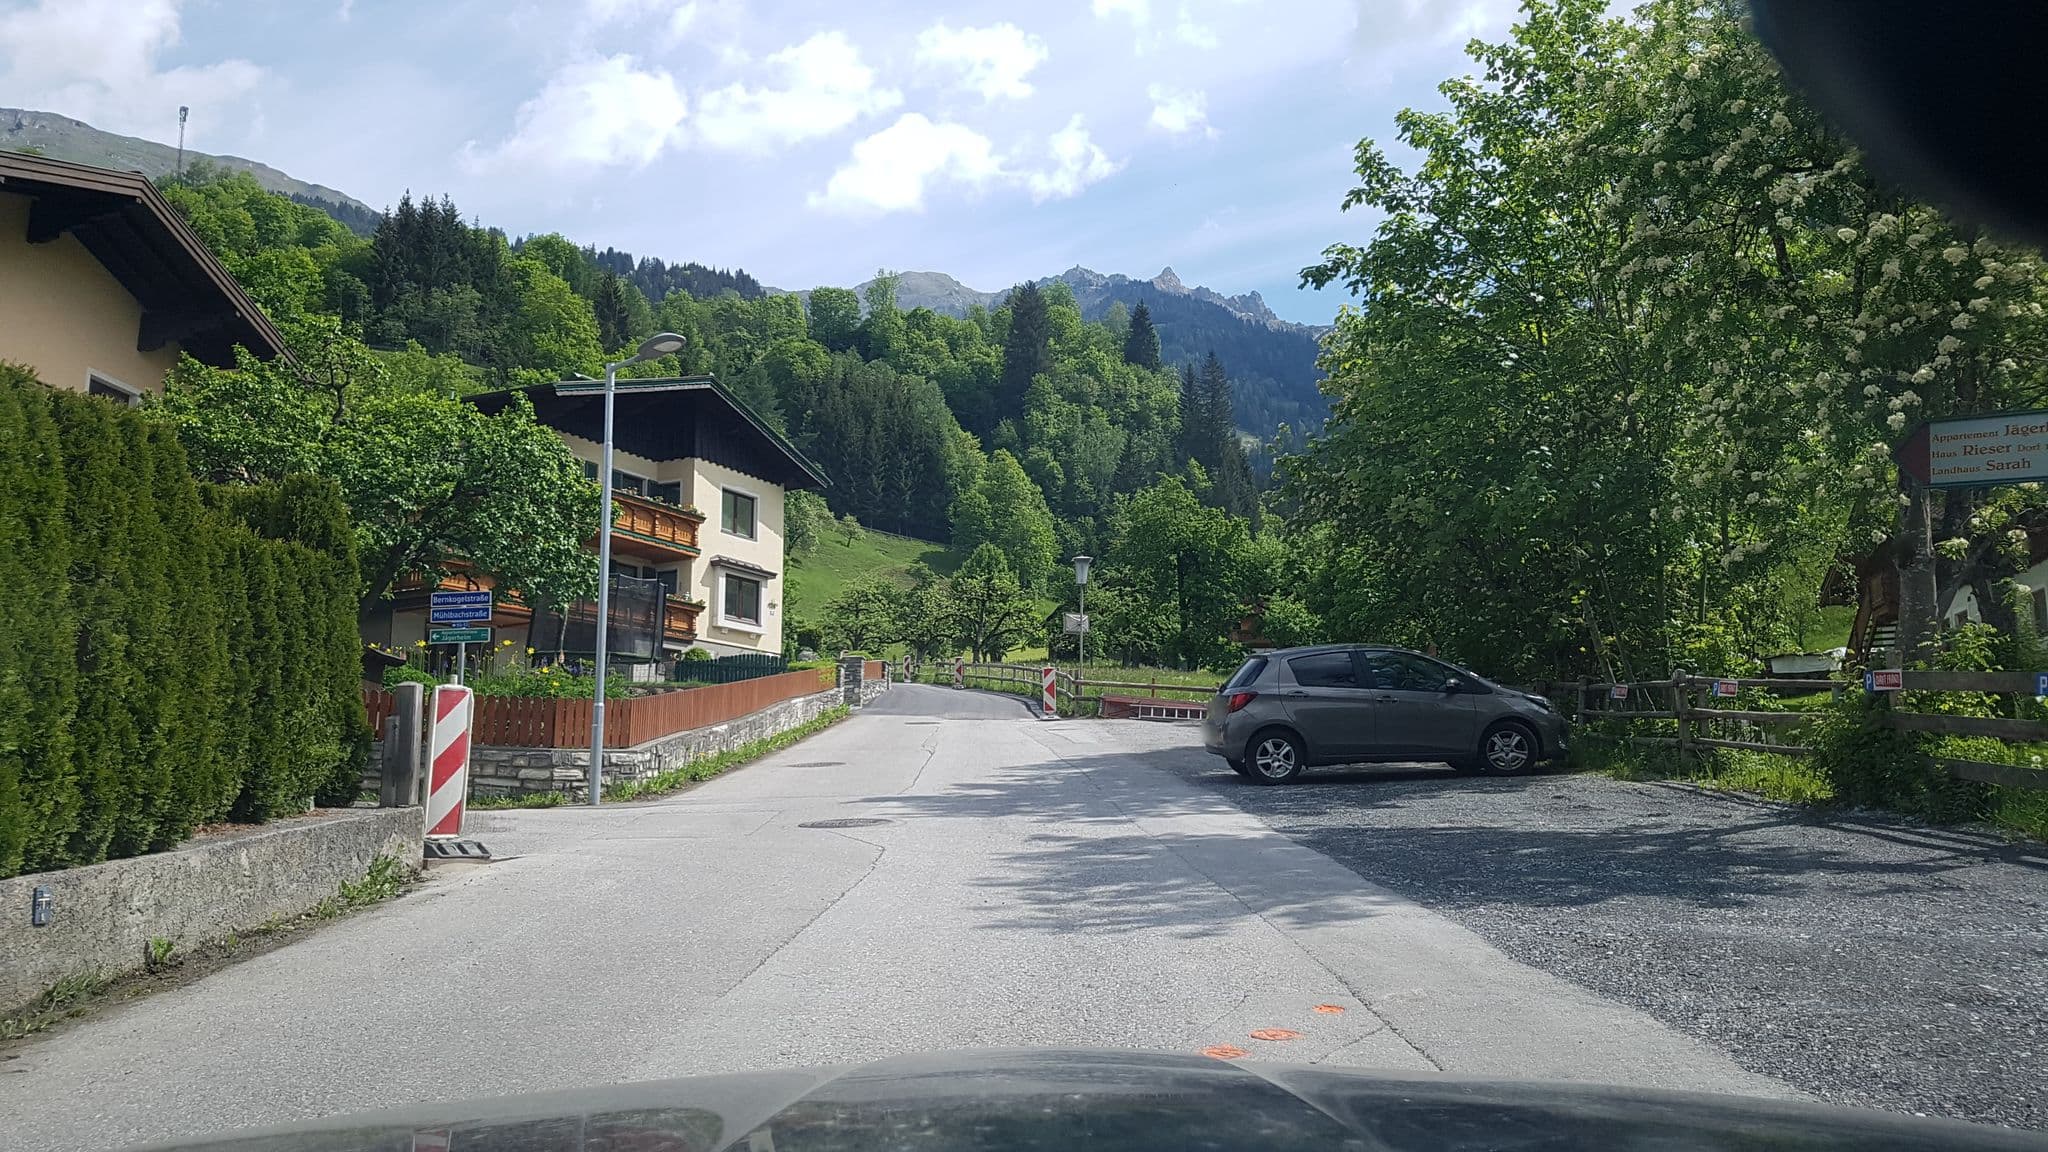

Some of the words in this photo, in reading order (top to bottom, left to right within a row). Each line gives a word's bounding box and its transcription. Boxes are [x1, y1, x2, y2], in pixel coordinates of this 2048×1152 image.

[1932, 431, 1999, 443] Appartement
[1932, 450, 1957, 459] Haus
[1963, 444, 2012, 456] Rieser
[2017, 443, 2040, 452] Dorf
[1932, 465, 1981, 476] Landhaus
[1985, 458, 2031, 472] Sarah
[433, 594, 489, 604] Bernkogelstraße
[433, 610, 488, 619] Mühlbachstraße
